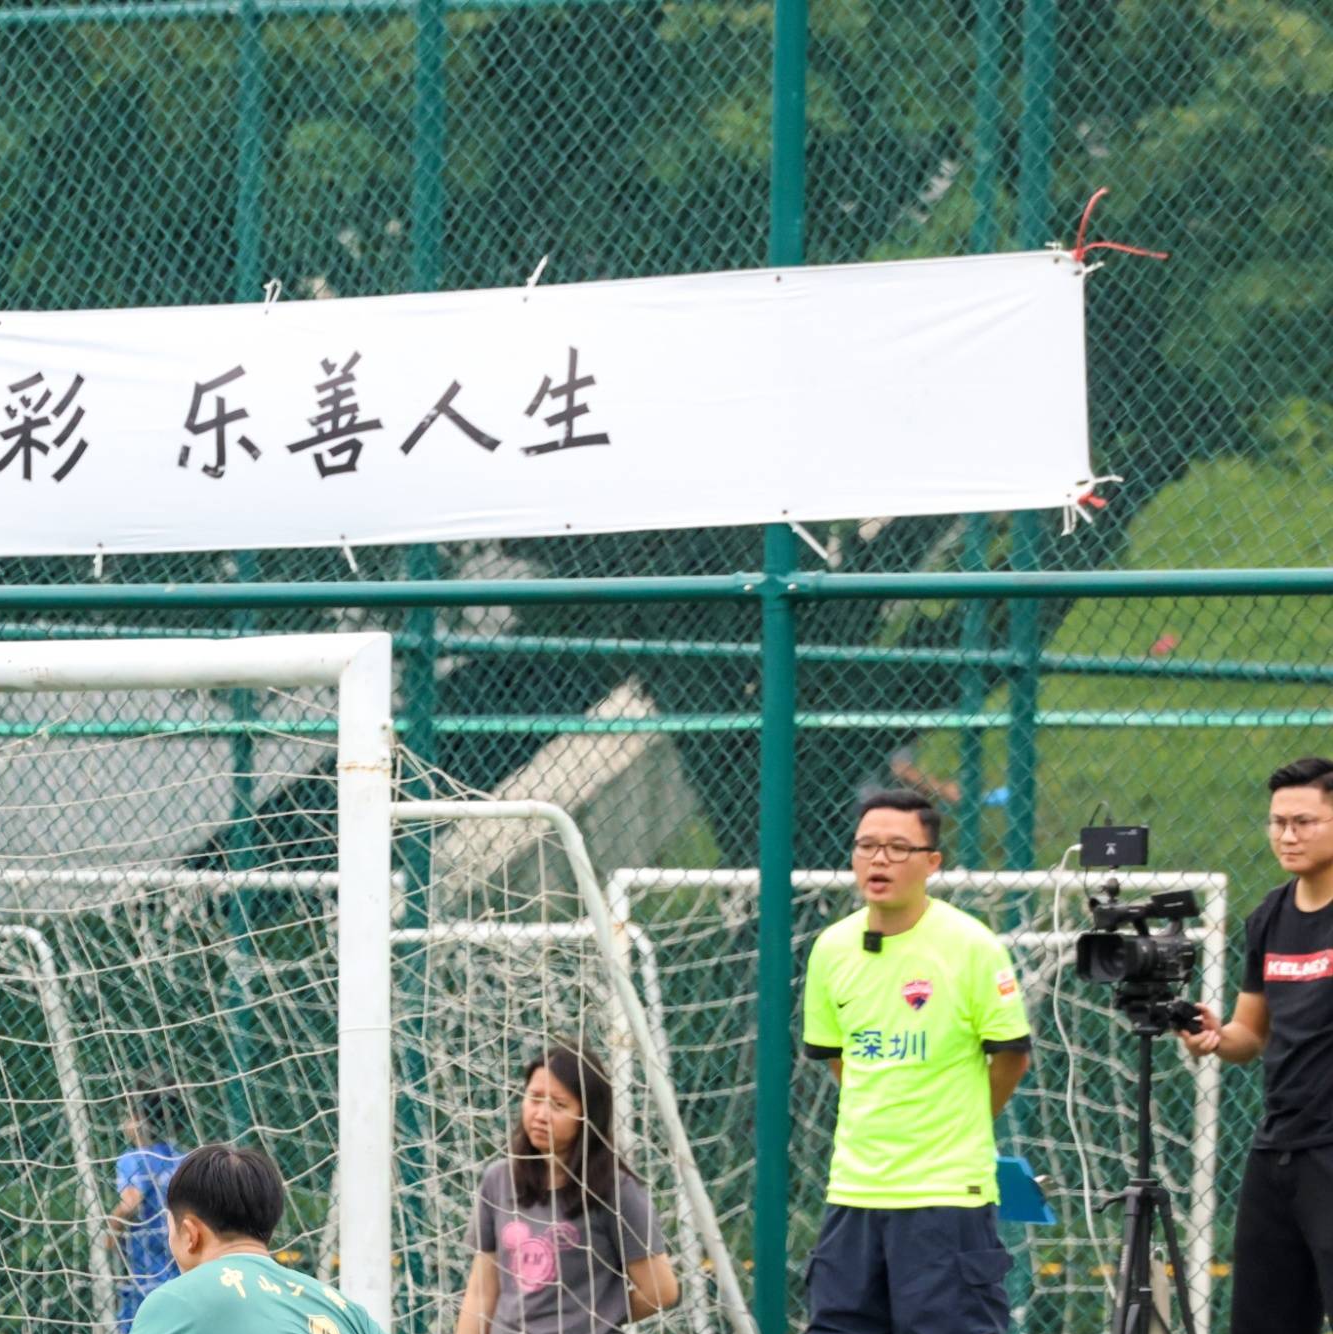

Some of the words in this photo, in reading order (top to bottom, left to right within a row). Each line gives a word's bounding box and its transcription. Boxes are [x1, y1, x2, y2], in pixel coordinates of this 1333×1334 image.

[177, 347, 611, 480] 乐善人生
[850, 1030, 926, 1061] 深圳
